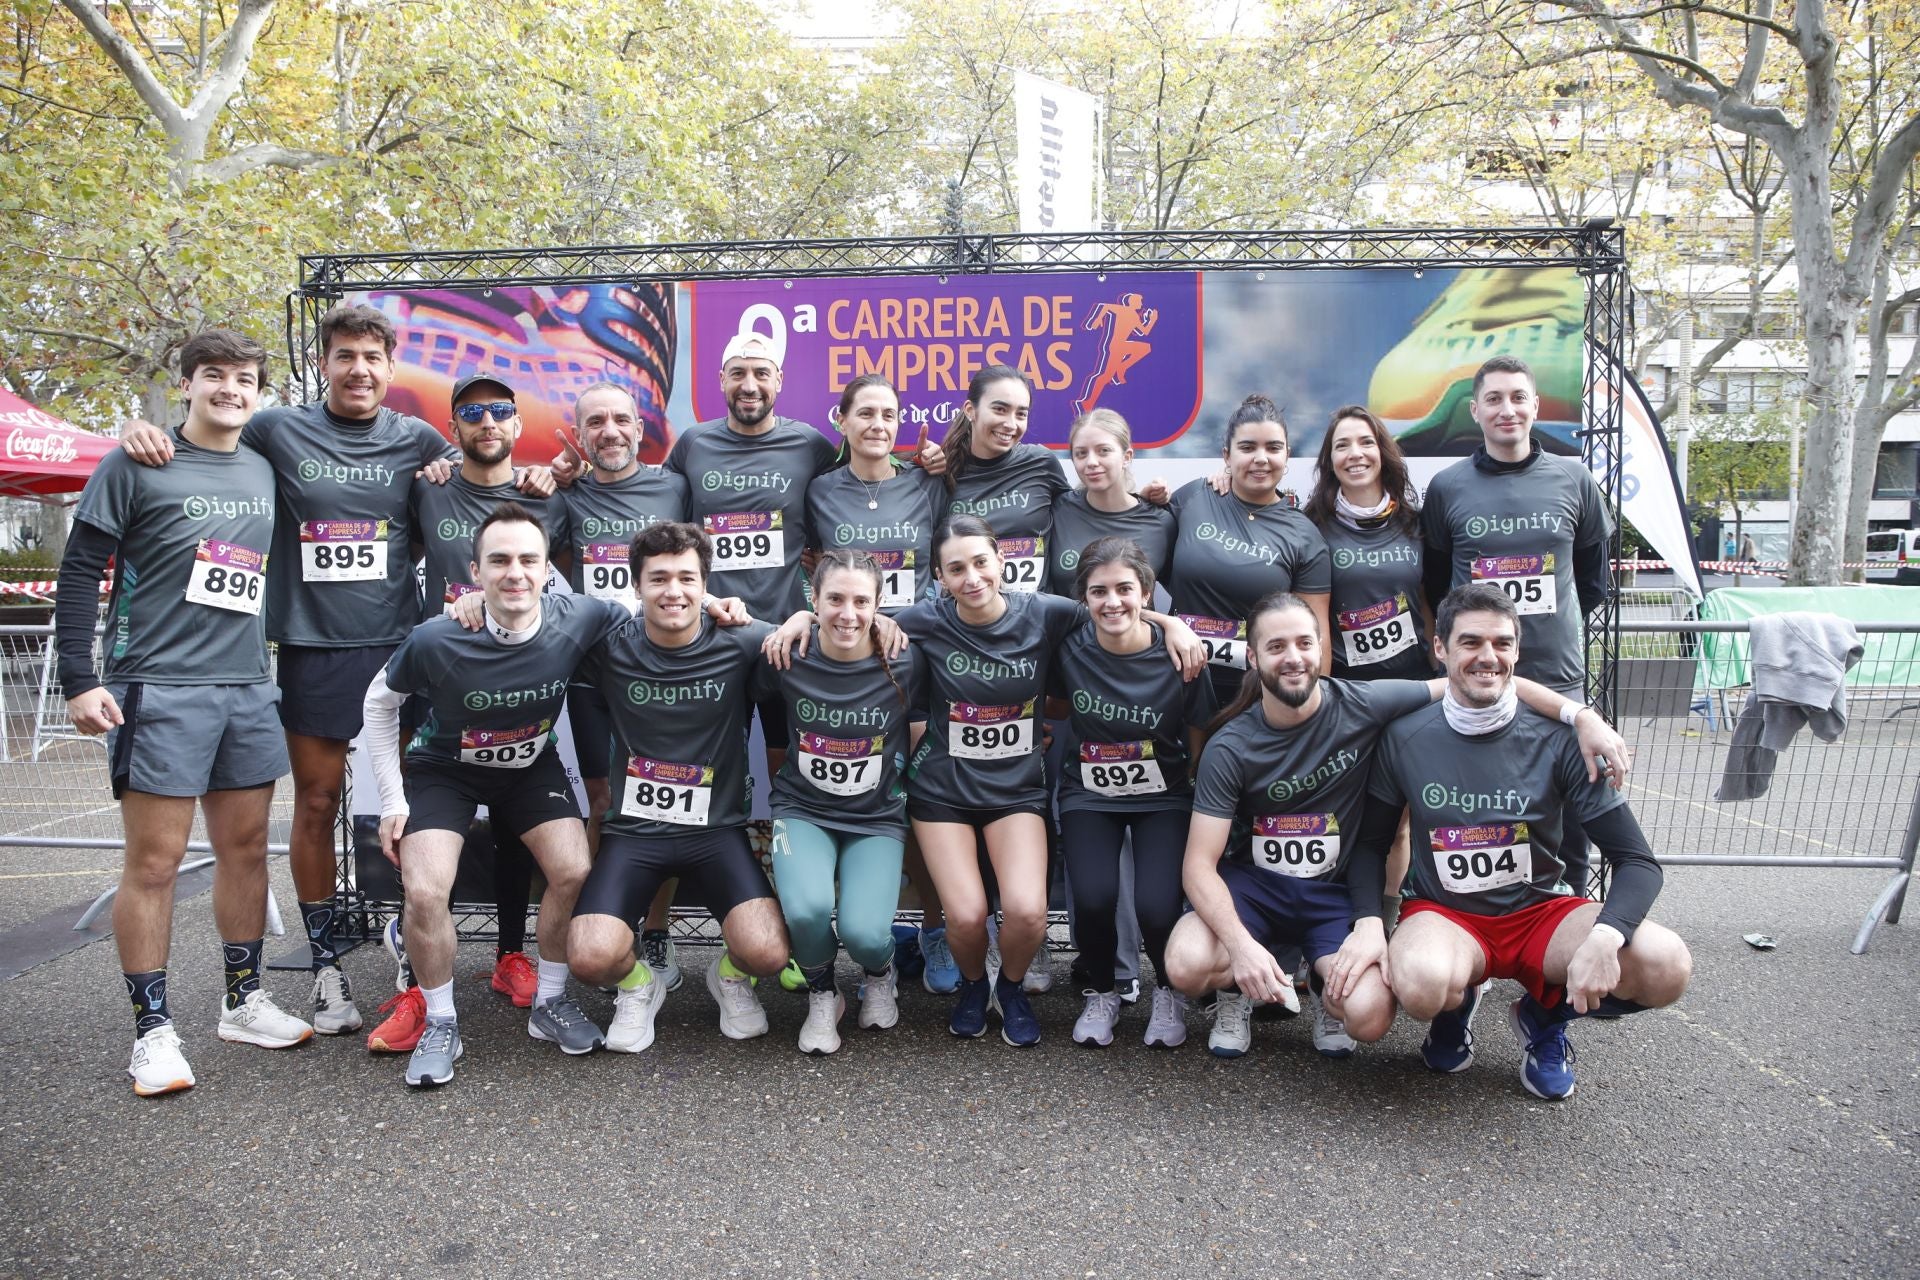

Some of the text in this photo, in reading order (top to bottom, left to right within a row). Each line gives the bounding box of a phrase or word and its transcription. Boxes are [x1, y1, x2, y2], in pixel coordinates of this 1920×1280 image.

[827, 297, 1011, 341] CARRERA
[1023, 295, 1073, 336] DE
[828, 341, 1073, 393] EMPRESAS
[909, 404, 930, 423] de
[6, 428, 79, 463] Coca-Cola
[582, 515, 660, 538] signif
[314, 545, 375, 569] 895
[716, 534, 771, 560] 899
[204, 567, 259, 600] 896
[593, 567, 629, 590] 90
[1002, 560, 1036, 584] 02
[1487, 579, 1542, 604] 05
[117, 616, 129, 646] RUN
[1353, 620, 1403, 654] 889
[962, 724, 1020, 749] 890
[474, 741, 536, 762] 903
[911, 742, 931, 769] RUN
[810, 758, 869, 784] 897
[1091, 763, 1150, 788] 892
[636, 782, 694, 813] 891
[1263, 839, 1326, 865] 906
[1447, 849, 1517, 881] 904
